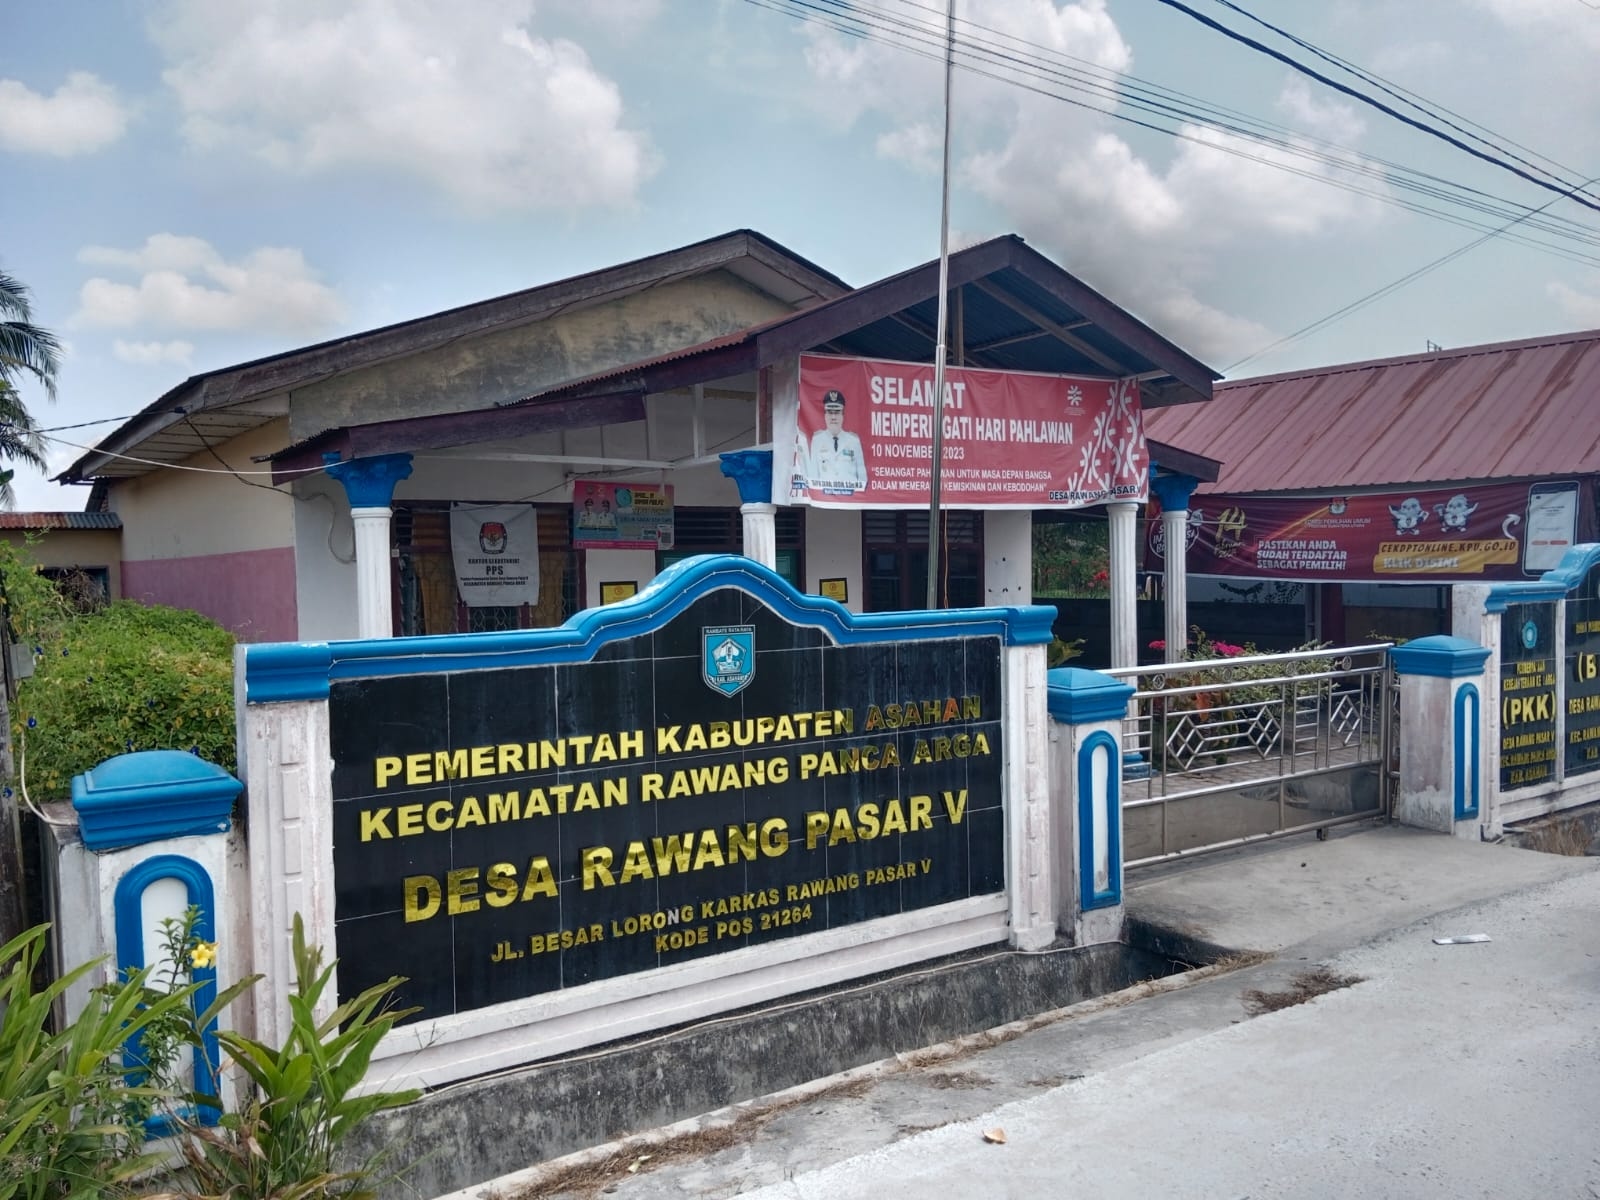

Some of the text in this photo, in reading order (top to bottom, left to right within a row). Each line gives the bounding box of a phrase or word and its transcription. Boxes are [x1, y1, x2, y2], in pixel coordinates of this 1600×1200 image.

[871, 376, 965, 409] SELAMAT
[871, 411, 1073, 444] MEMPERIGATI HARI PAHLAWAN
[871, 444, 965, 460] 10 NOVEMBE 2023
[872, 480, 897, 490] DALAM
[944, 482, 986, 492] KEMISKINAN
[987, 483, 1001, 492] DAN
[917, 468, 955, 478] PAHWAN
[956, 469, 980, 479] UNTUK
[981, 469, 1000, 479] MASA
[1002, 470, 1024, 480] DEPAN
[1025, 470, 1052, 480] BANGSA
[1049, 491, 1068, 500] DESA
[1257, 550, 1347, 560] SUDAH TERDAFTAR
[1258, 540, 1337, 550] PASTIKAN ANDA
[486, 565, 504, 576] PPS
[1257, 560, 1346, 571] SEBAGAI PEMILIH!
[1503, 690, 1556, 730] (PKK)
[375, 696, 981, 788] PEMERINTAH KABUPATEN ASAHAN
[360, 732, 991, 842] KECAMATAN RAWANG PANCA ARGA
[404, 789, 968, 923] DESA RAWANG PASAR V
[491, 858, 932, 962] JL. BESAR LORONG KARKAS RAWANG PASAR V
[655, 904, 813, 953] KODE POS 21264
